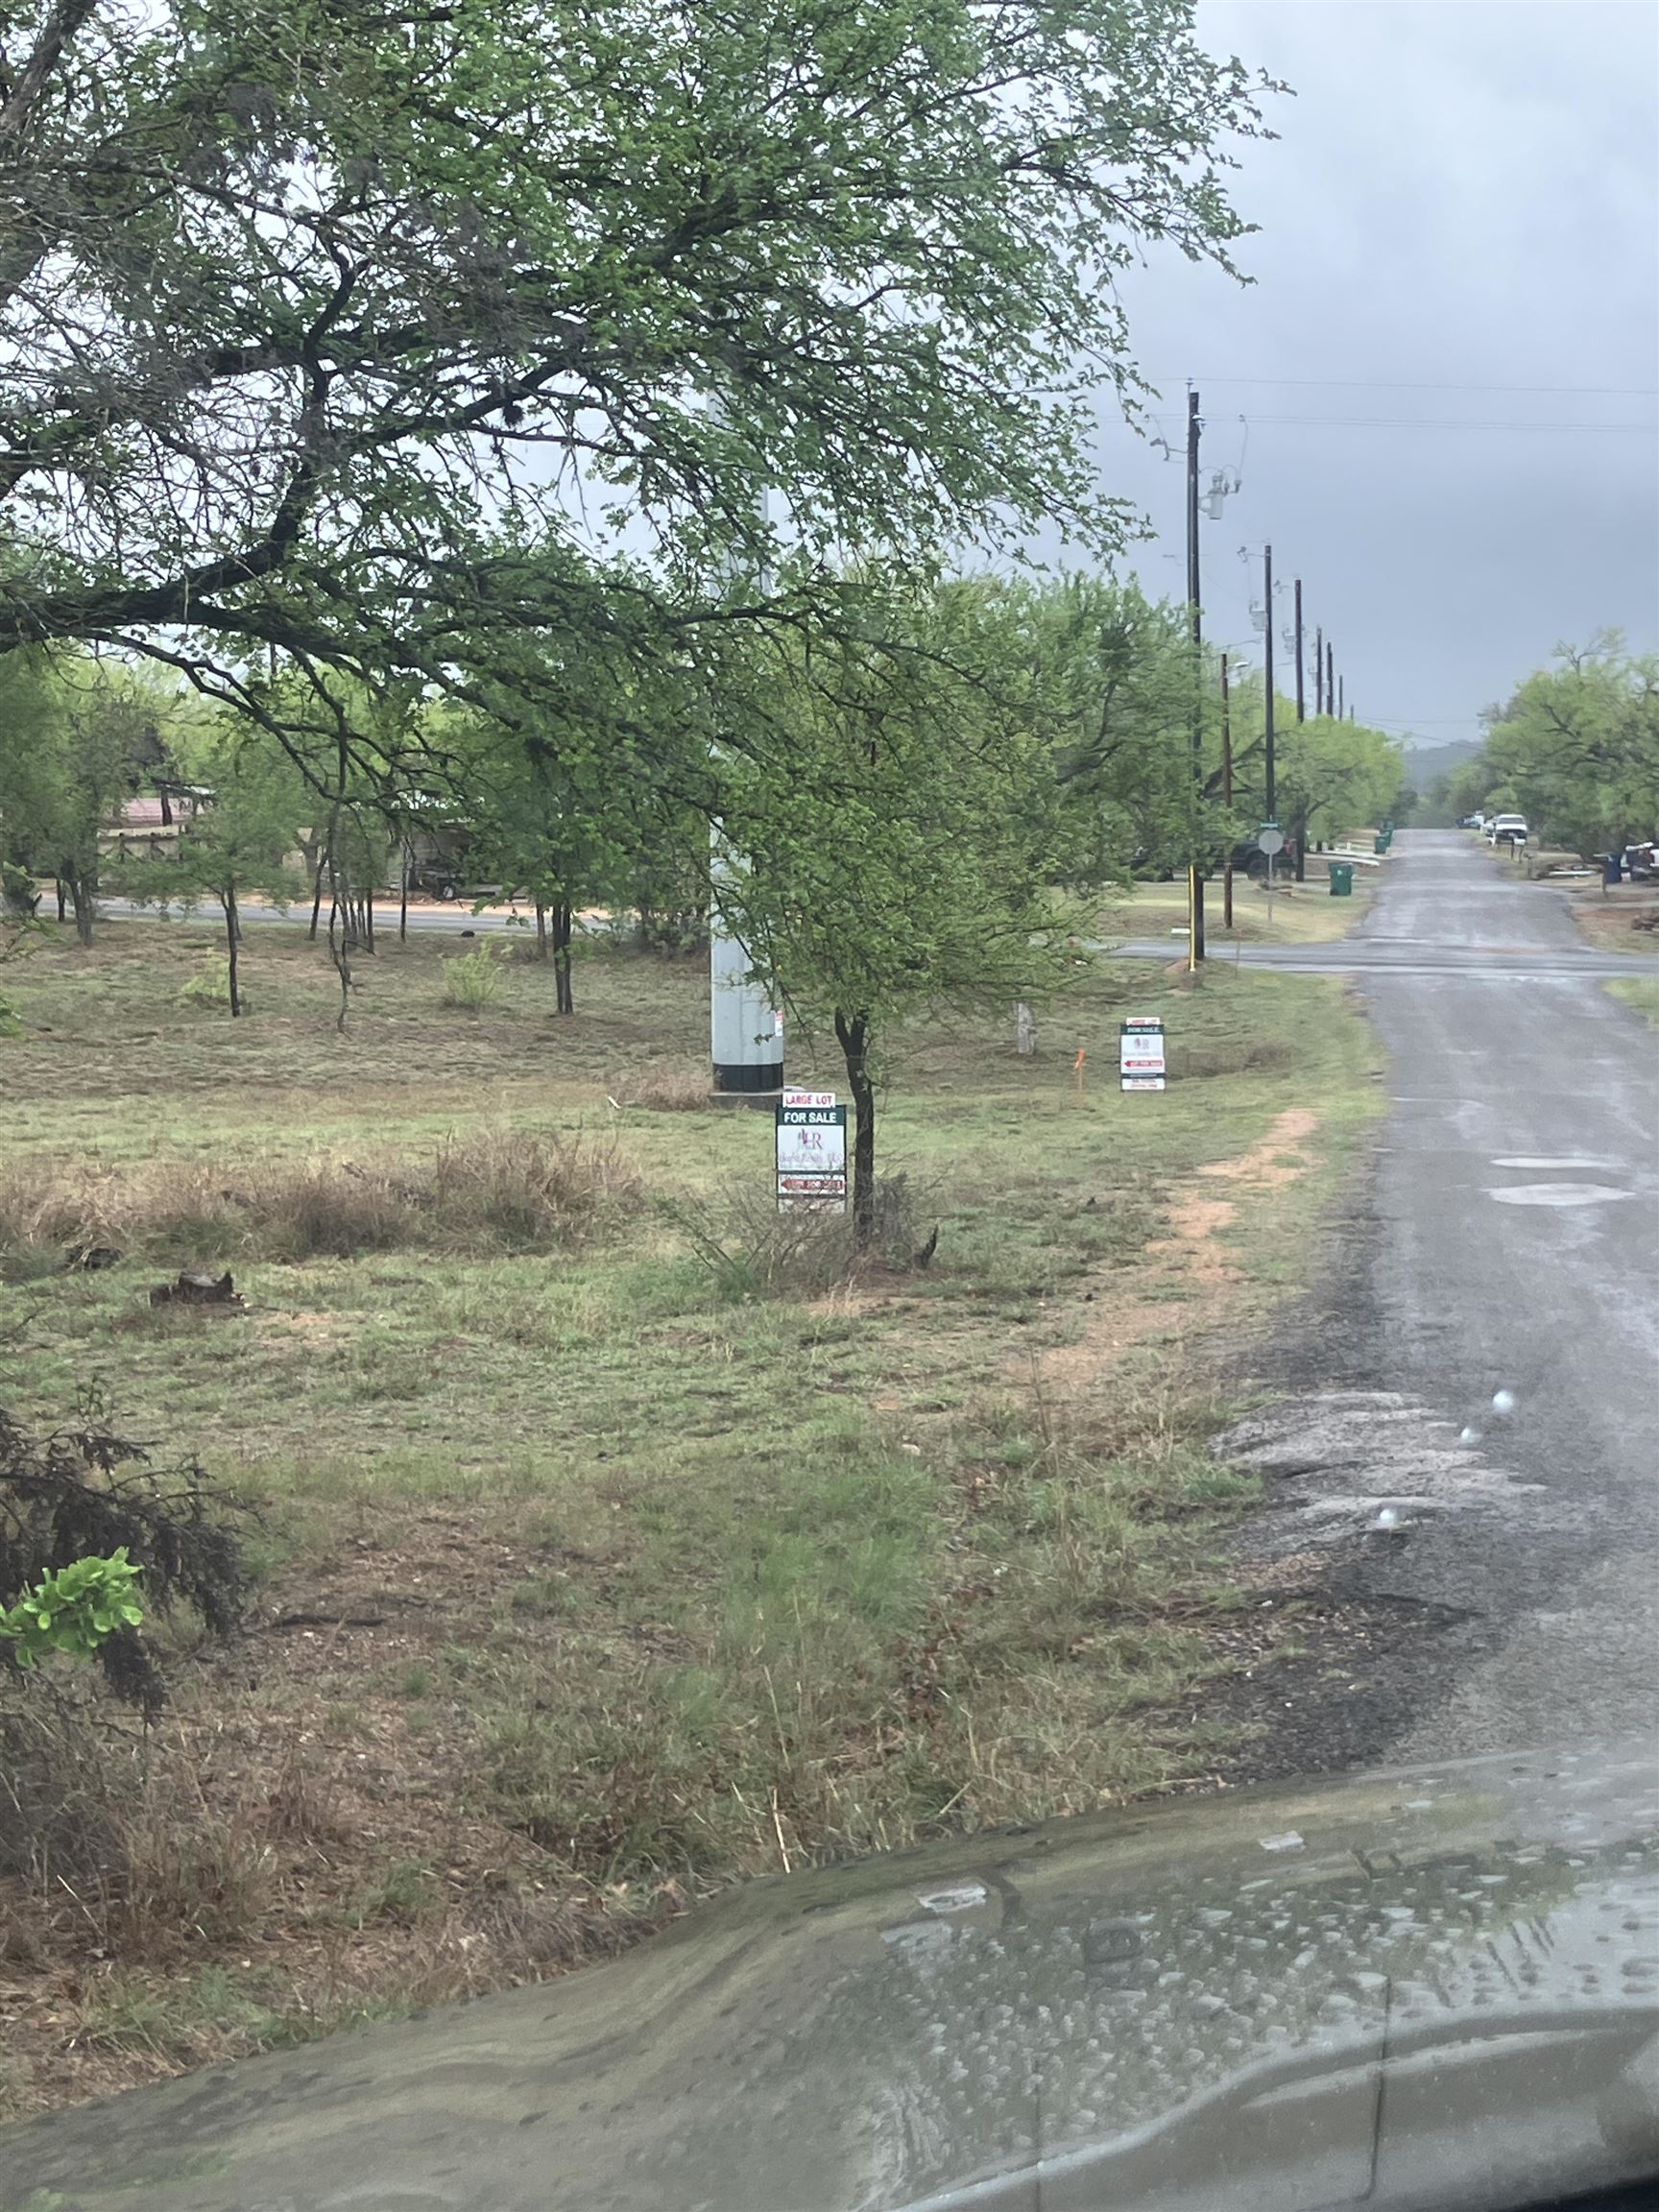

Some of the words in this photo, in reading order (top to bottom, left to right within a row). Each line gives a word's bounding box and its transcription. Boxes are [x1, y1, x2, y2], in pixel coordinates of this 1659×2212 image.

[785, 1095, 812, 1105] LARGE
[816, 1095, 832, 1105] LOT
[783, 1112, 806, 1123] FOR
[808, 1112, 836, 1123] SALE
